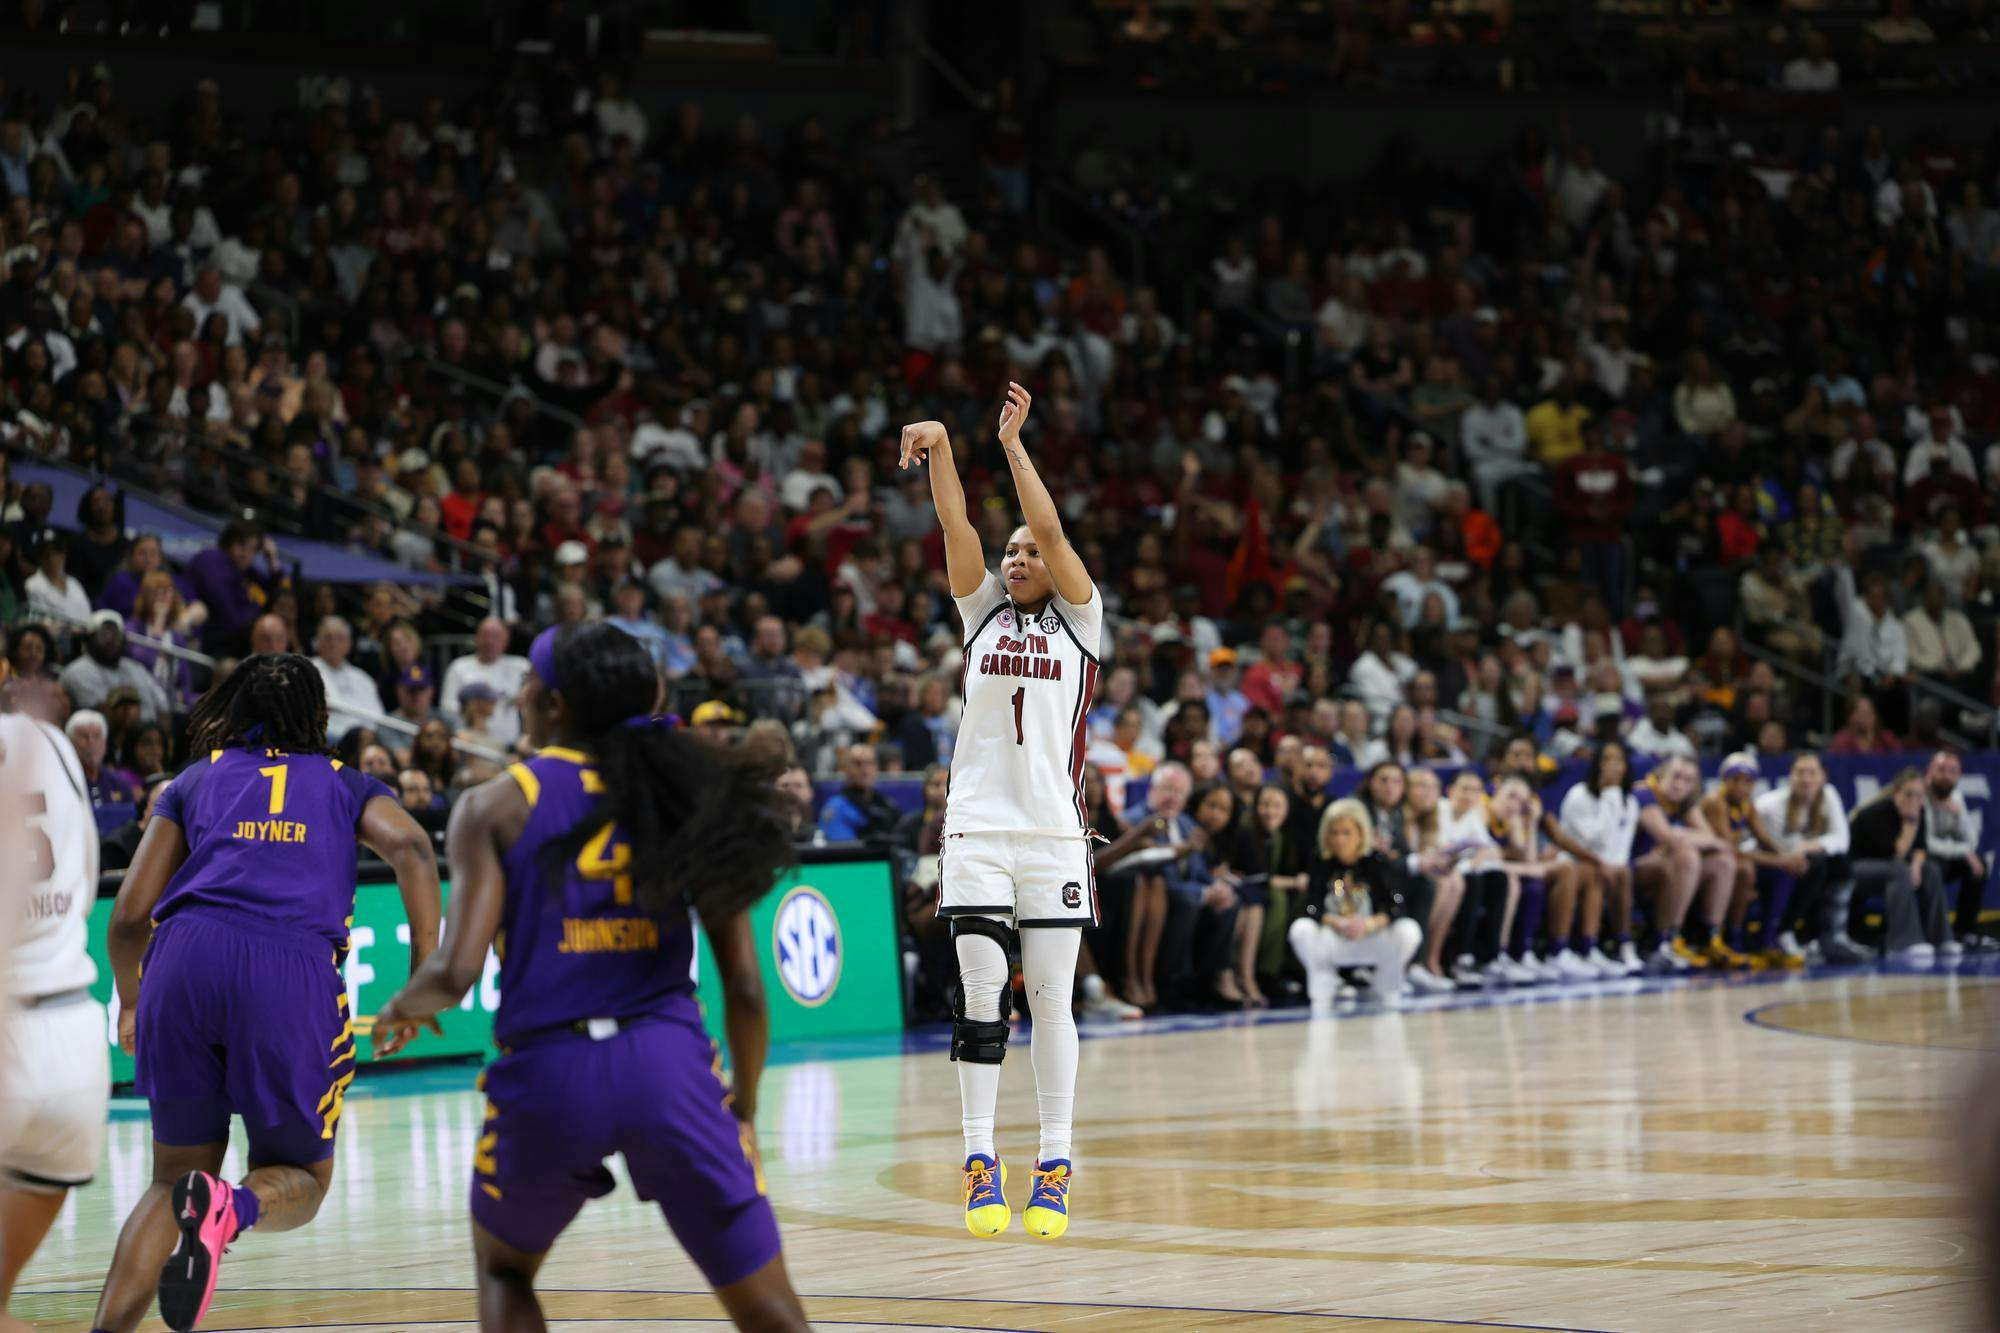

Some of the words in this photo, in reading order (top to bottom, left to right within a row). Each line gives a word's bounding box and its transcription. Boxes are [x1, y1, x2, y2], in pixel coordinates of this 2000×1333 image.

[1041, 617, 1059, 633] SEC
[980, 653, 1062, 681] CAROLINA
[1011, 686, 1025, 746] 1
[259, 764, 288, 815] 1
[232, 820, 307, 843] JOYNER
[576, 819, 633, 905] 4
[558, 918, 659, 953] JOHNSON
[779, 893, 837, 999] SEC
